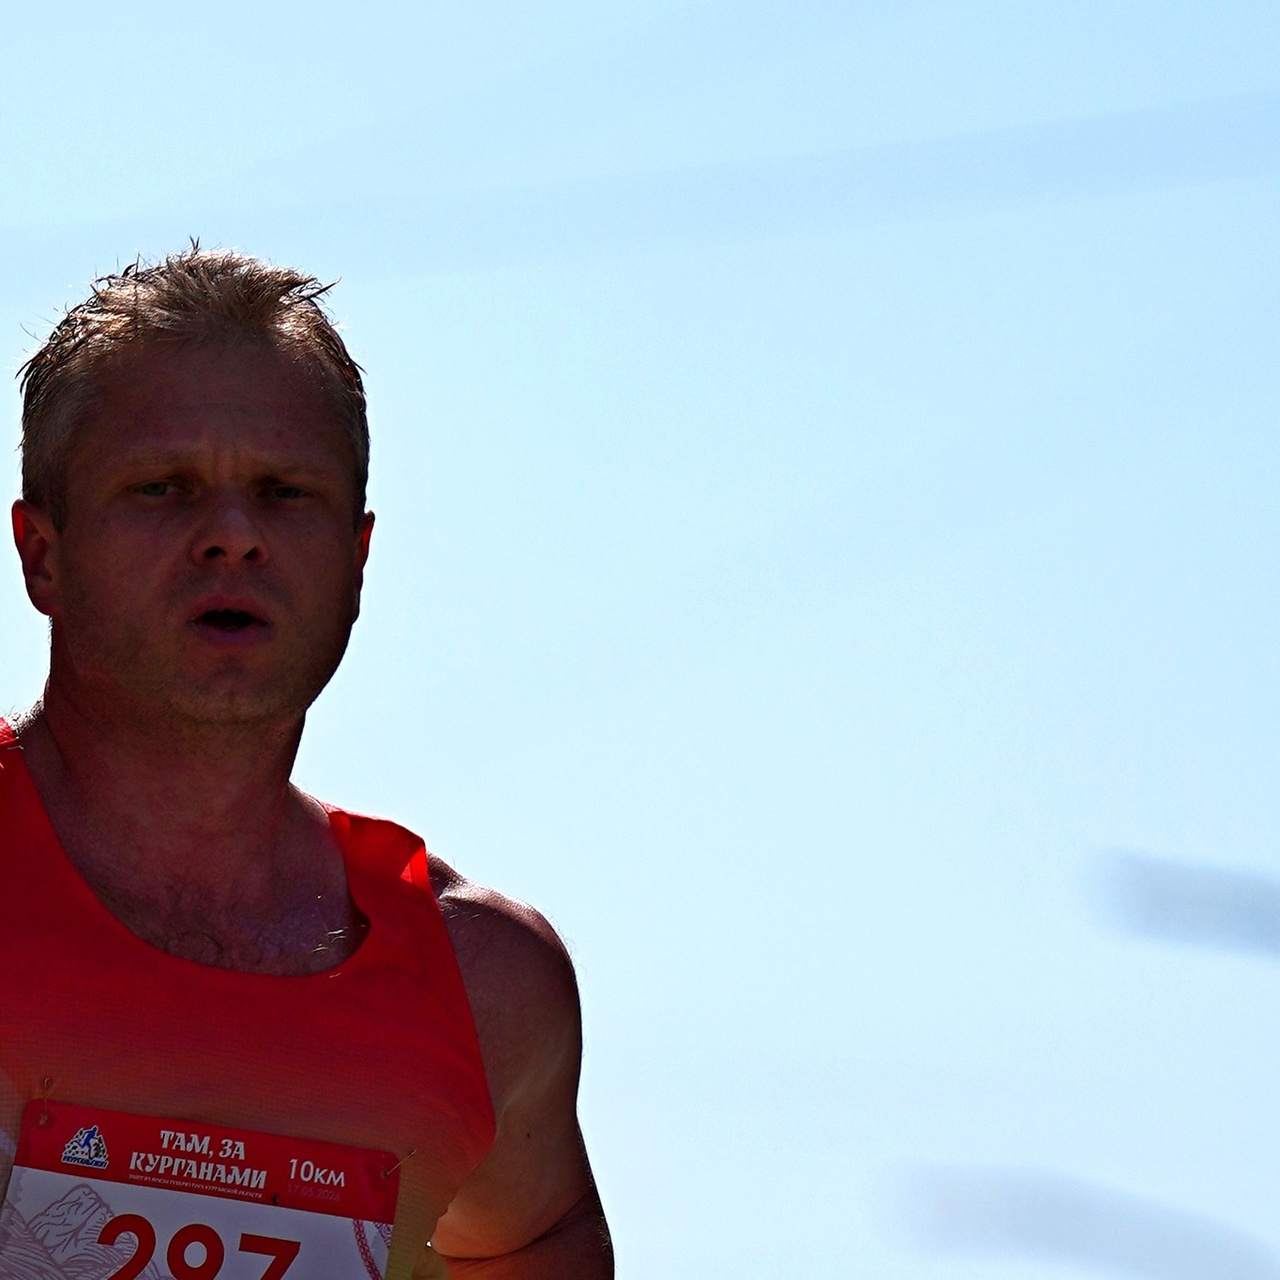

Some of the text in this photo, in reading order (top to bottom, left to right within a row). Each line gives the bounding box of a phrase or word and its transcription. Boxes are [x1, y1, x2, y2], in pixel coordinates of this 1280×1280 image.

[160, 1129, 246, 1161] ТАМ, ЗА
[129, 1151, 267, 1190] КУРГАНАМИ
